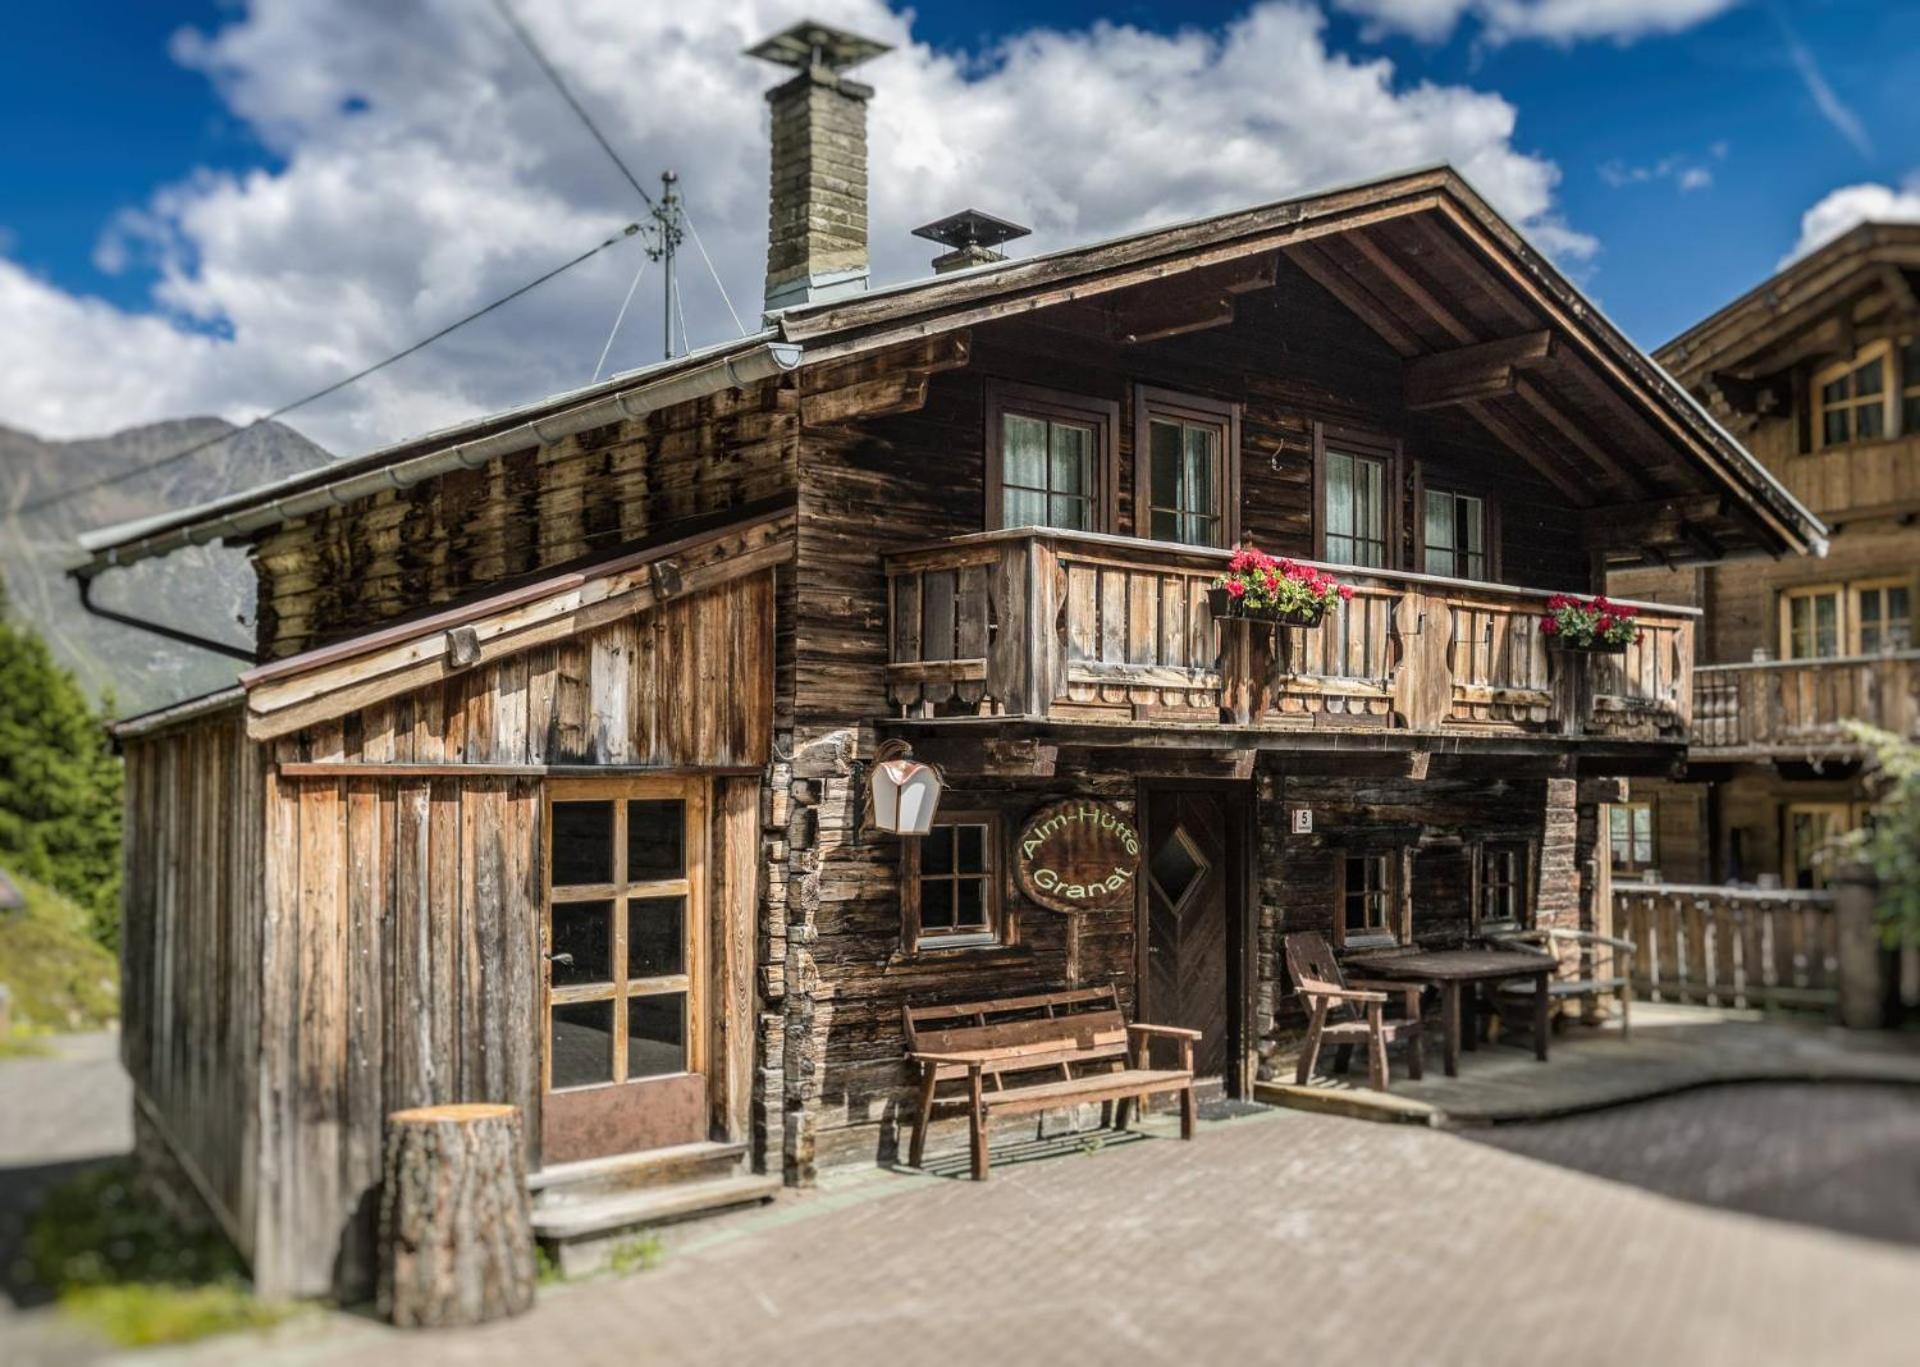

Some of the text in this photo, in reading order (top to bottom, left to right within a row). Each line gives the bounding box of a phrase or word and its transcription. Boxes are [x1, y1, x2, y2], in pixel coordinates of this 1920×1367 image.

[1023, 807, 1138, 860] Alm-Hütte
[1302, 811, 1308, 825] 5
[1033, 866, 1133, 898] Granat
